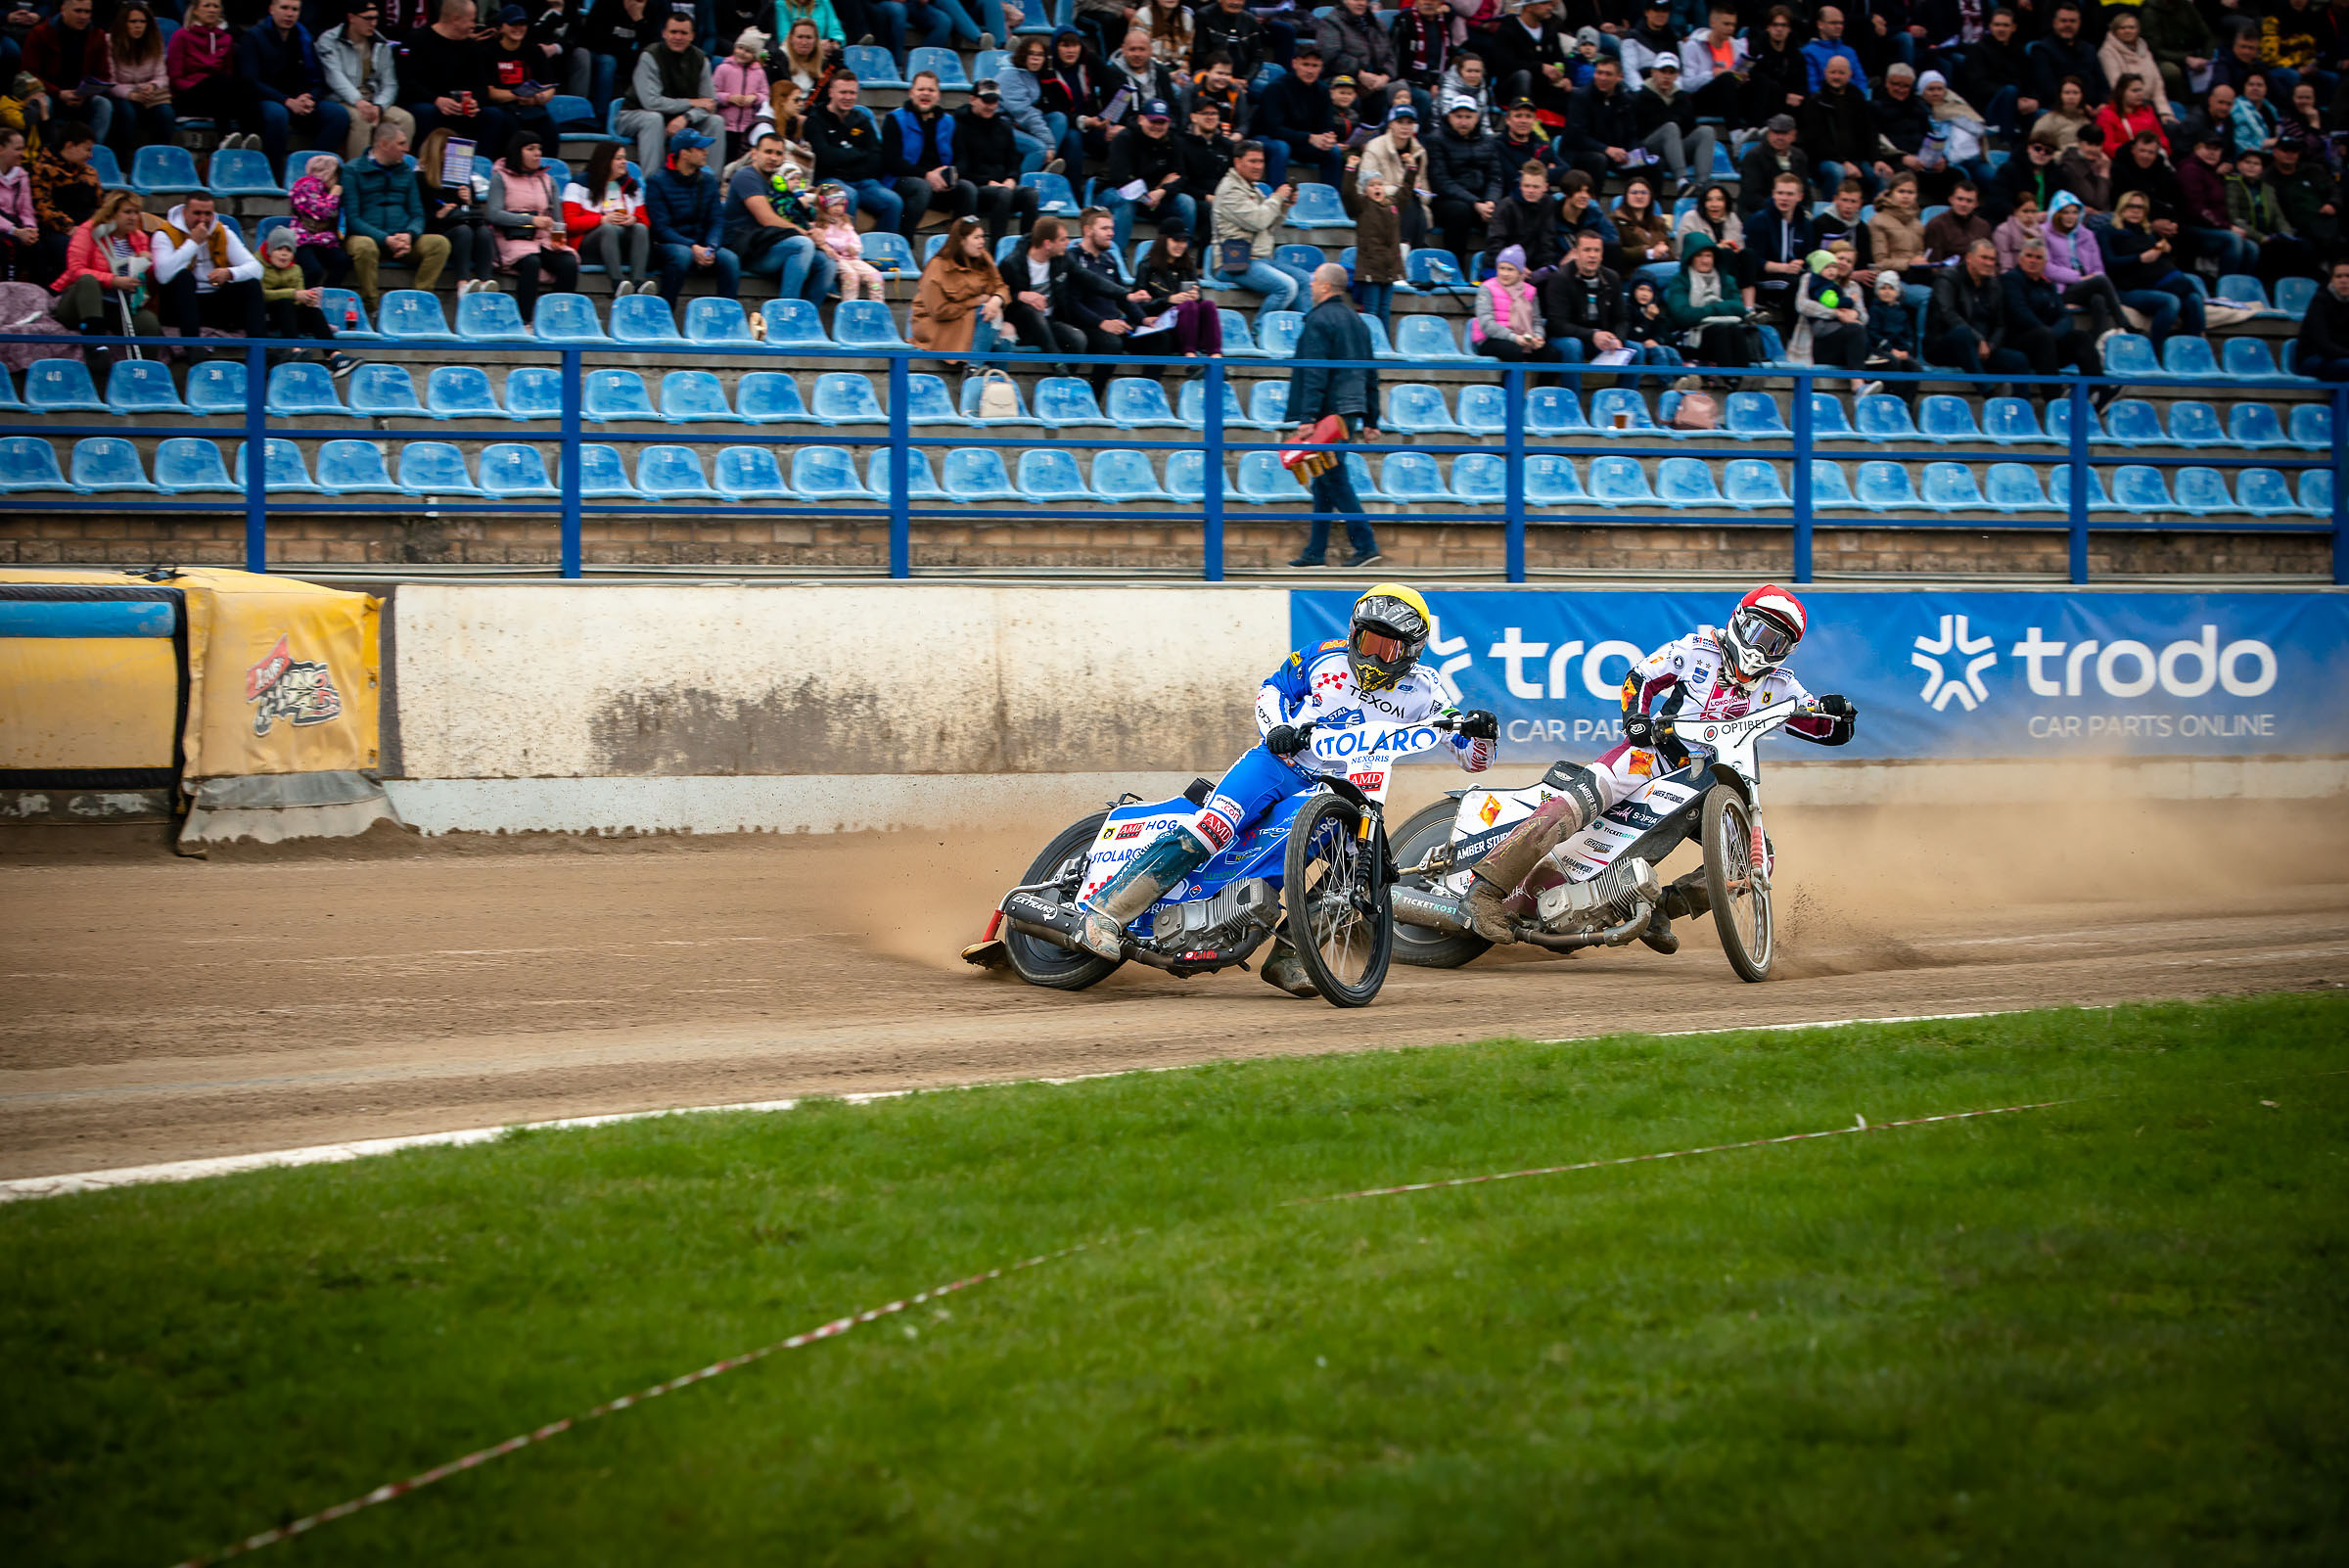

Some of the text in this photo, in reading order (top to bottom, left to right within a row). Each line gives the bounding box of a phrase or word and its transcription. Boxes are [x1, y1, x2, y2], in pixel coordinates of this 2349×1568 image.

[1488, 624, 1714, 700] tro
[2011, 623, 2278, 698] trodo
[1350, 684, 1405, 719] TEXOM
[1328, 707, 1348, 722] STAL
[1507, 719, 1565, 743] CAR
[1722, 718, 1767, 735] OPTIBET
[2028, 714, 2276, 738] CAR PARTS ONLINE
[1351, 755, 1389, 764] NEXORIS
[1351, 773, 1383, 785] AMD
[1119, 822, 1144, 834] AMD
[1145, 819, 1178, 831] HOG
[1205, 814, 1233, 843] AMD
[1456, 839, 1487, 861] AMBER
